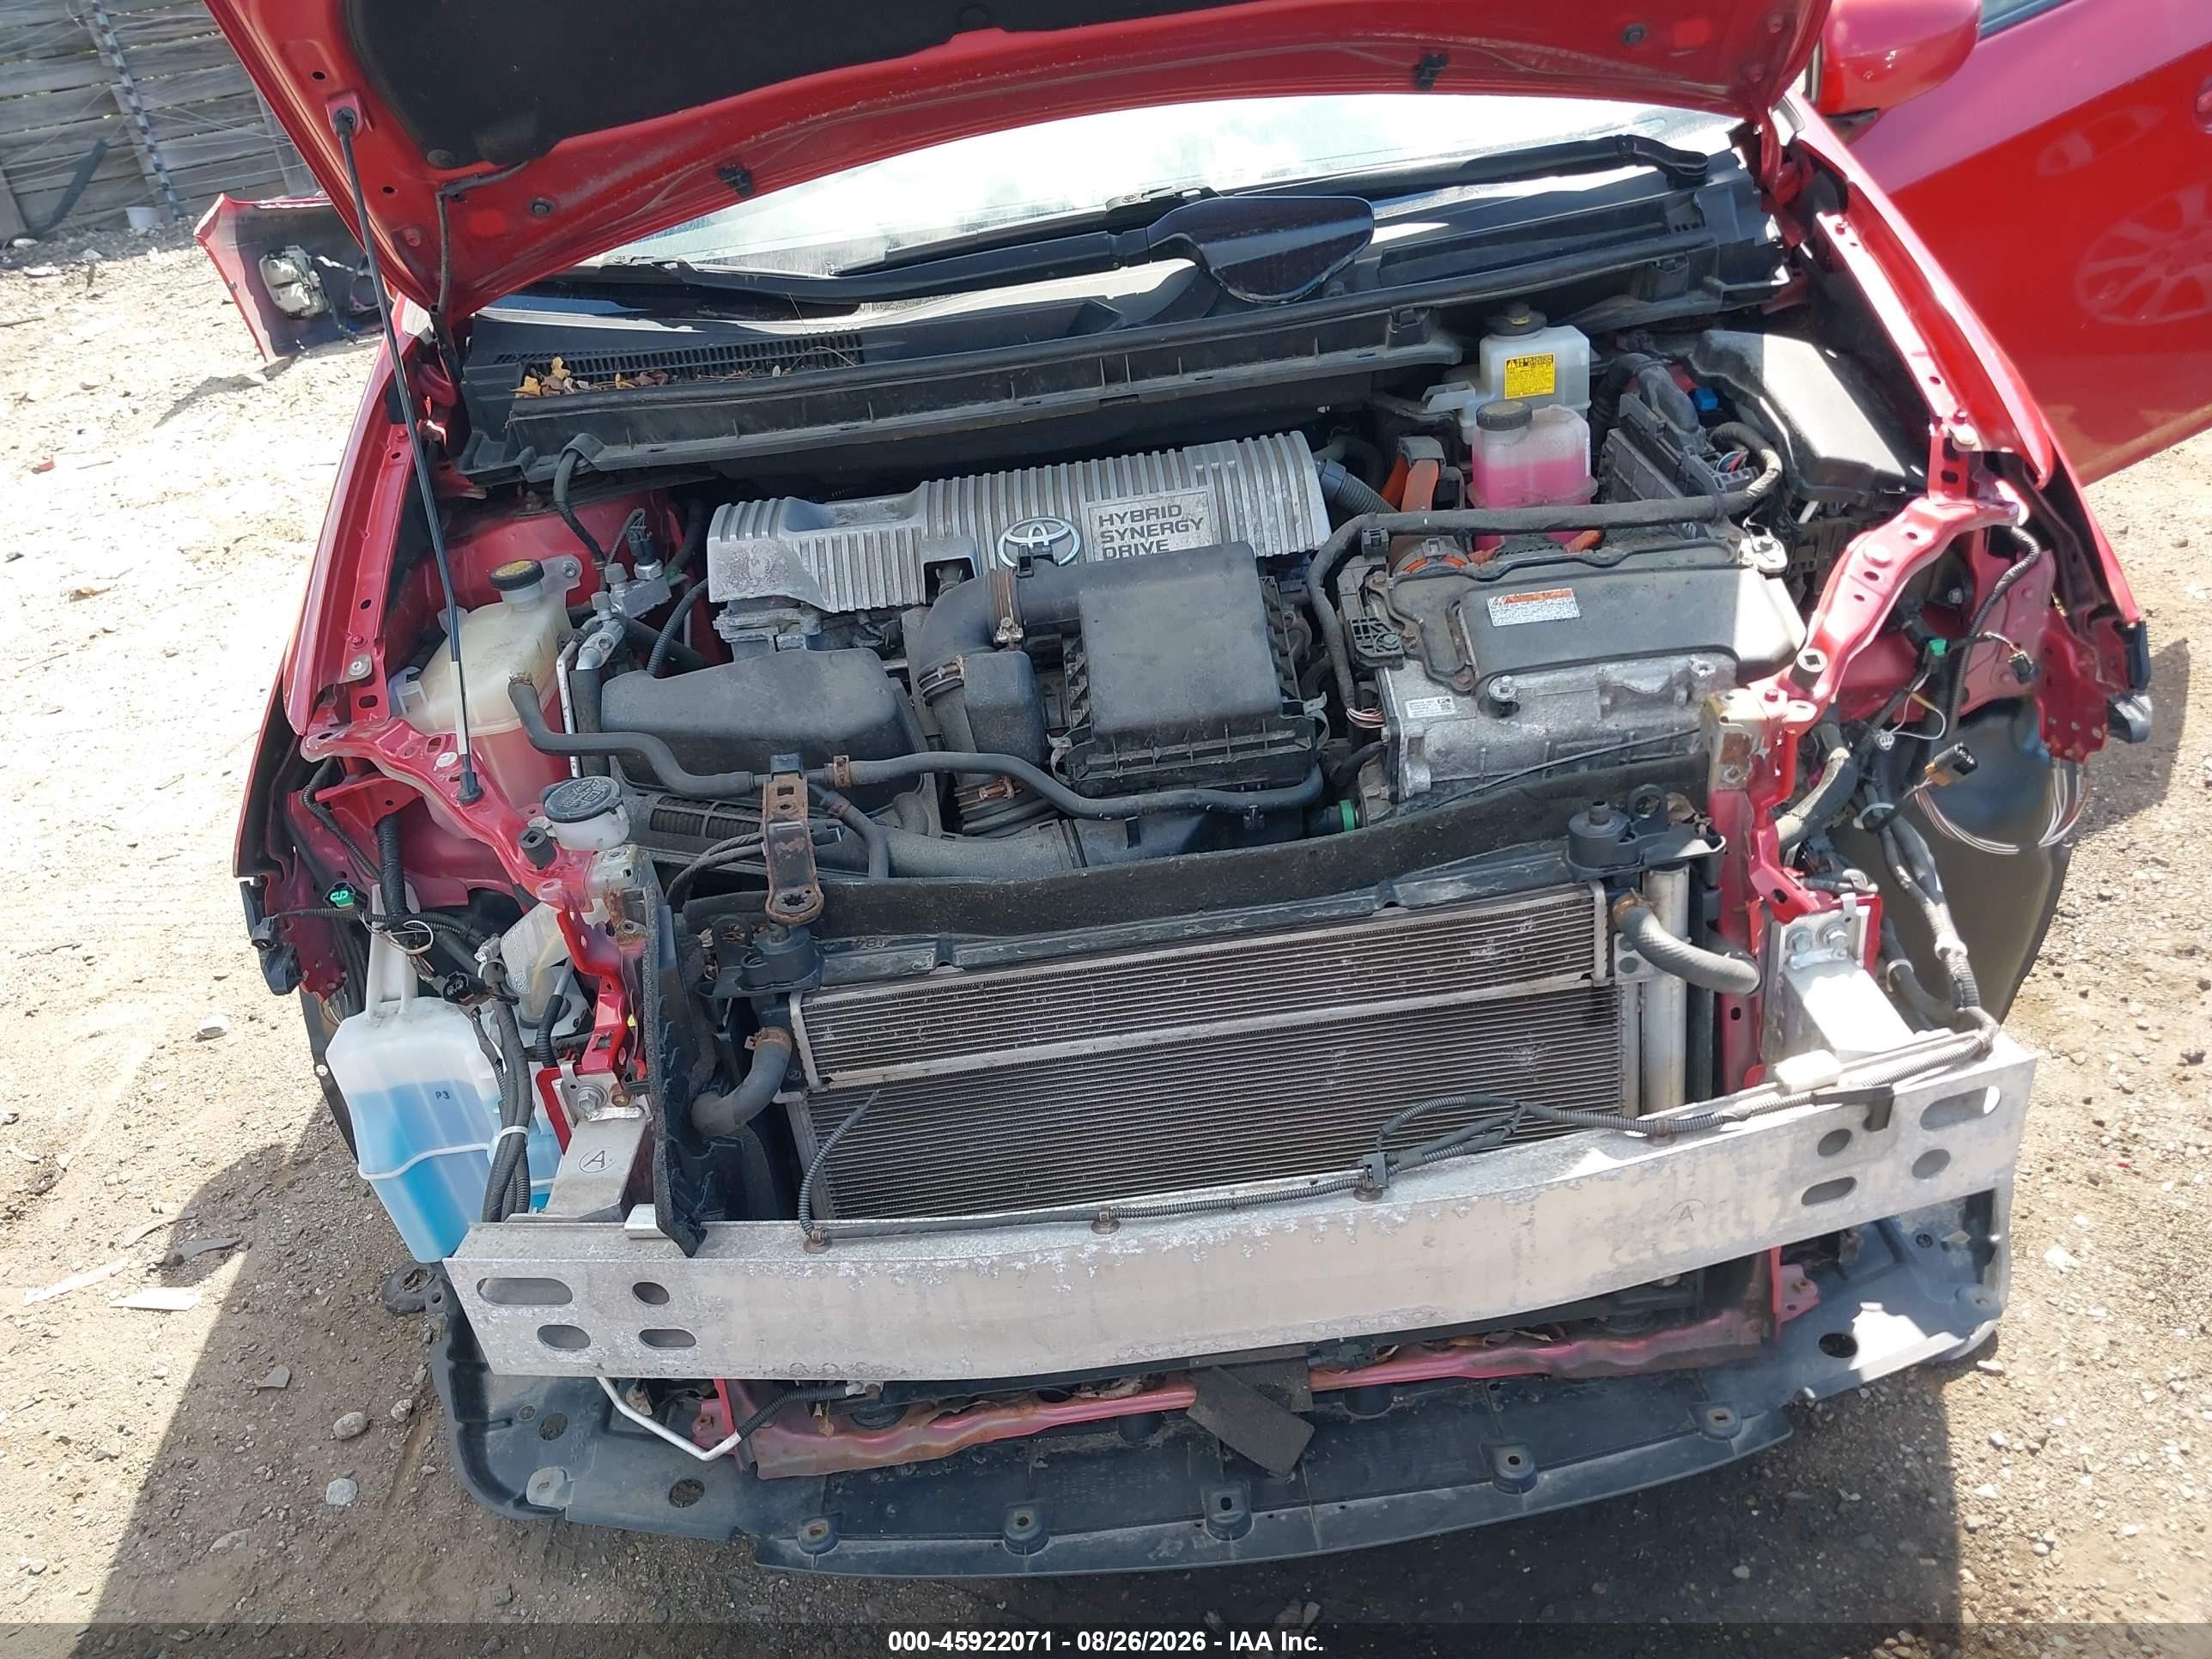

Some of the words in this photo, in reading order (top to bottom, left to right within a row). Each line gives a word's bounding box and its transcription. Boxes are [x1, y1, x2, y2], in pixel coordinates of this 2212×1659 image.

[1099, 504, 1182, 528] HYBRID
[1100, 517, 1204, 544] SYNERGY
[1103, 538, 1170, 559] DRIVE
[434, 1090, 451, 1100] P3
[582, 1150, 605, 1169] A
